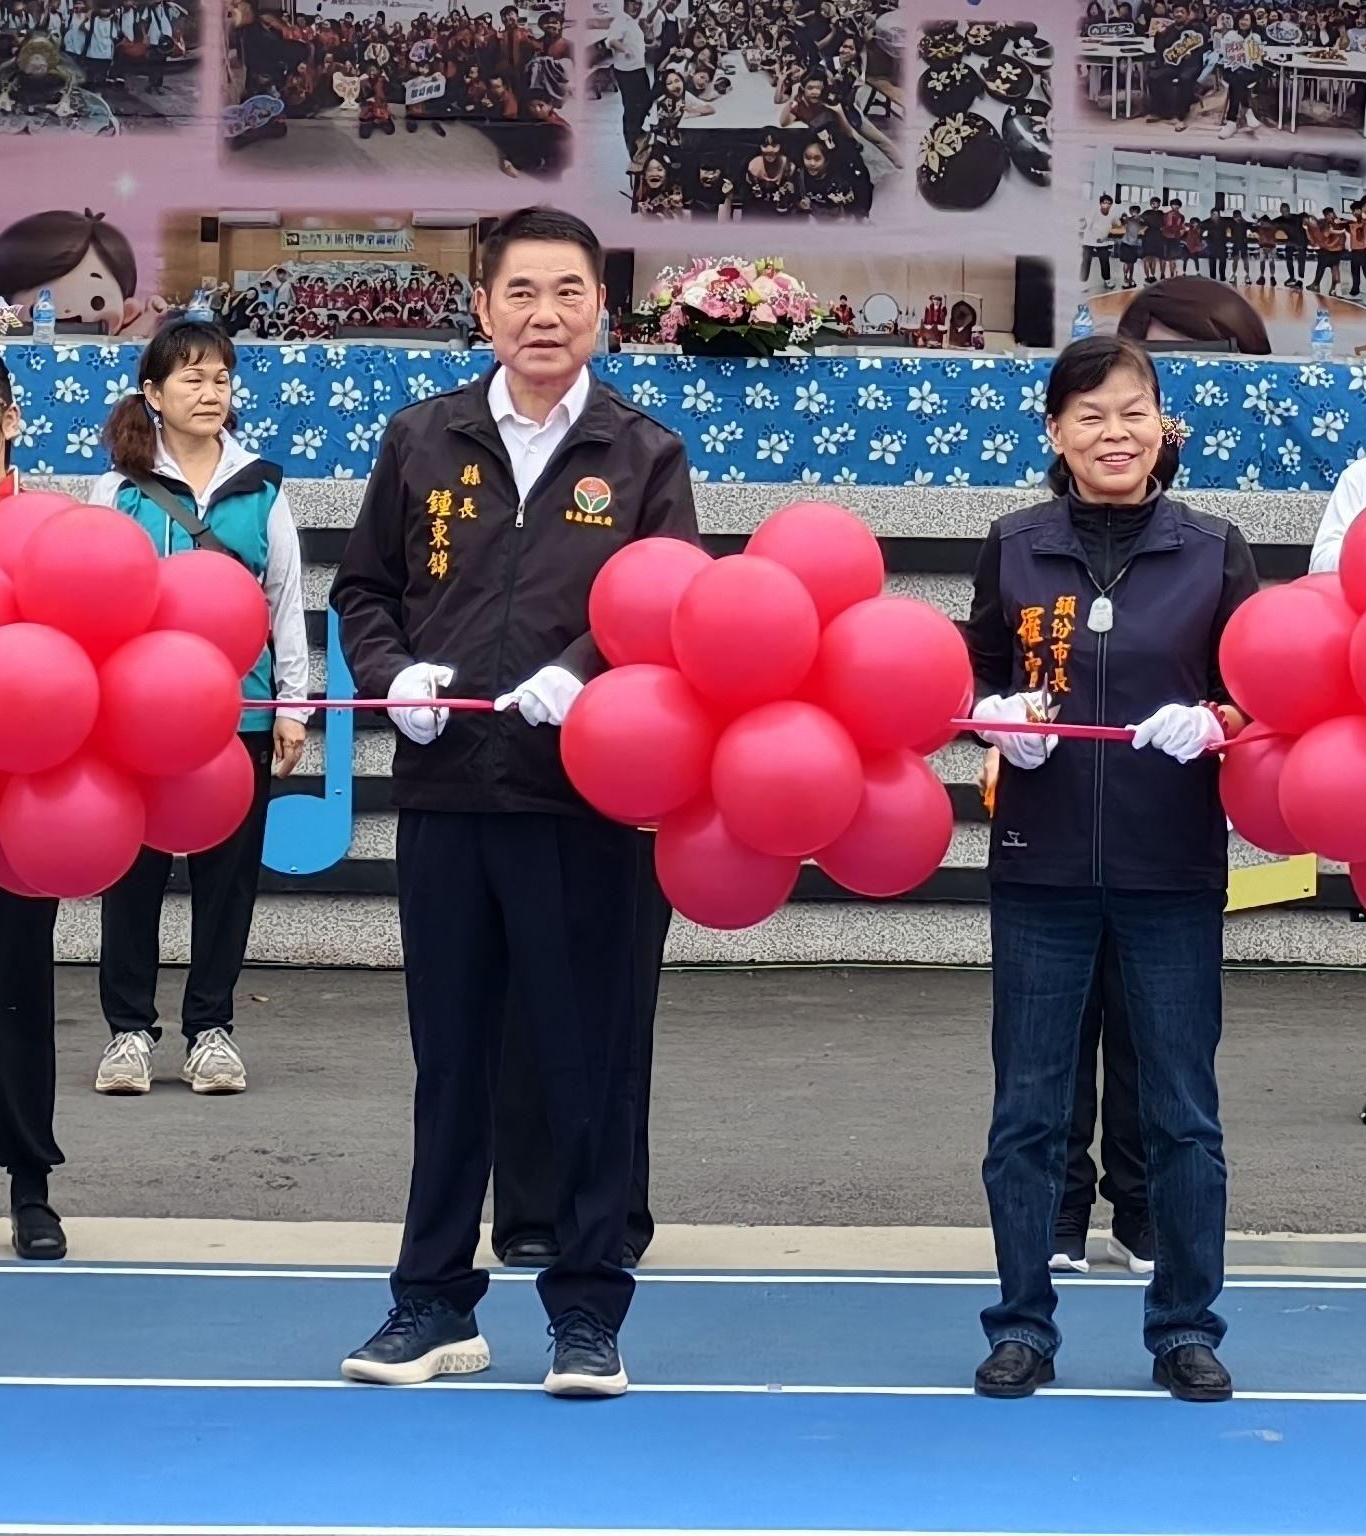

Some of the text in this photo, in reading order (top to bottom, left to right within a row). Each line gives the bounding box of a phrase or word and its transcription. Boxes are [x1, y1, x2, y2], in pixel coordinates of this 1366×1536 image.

[425, 489, 453, 581] 鍾東錦
[458, 463, 482, 520] 縣長
[1049, 595, 1077, 693] 頭份市長
